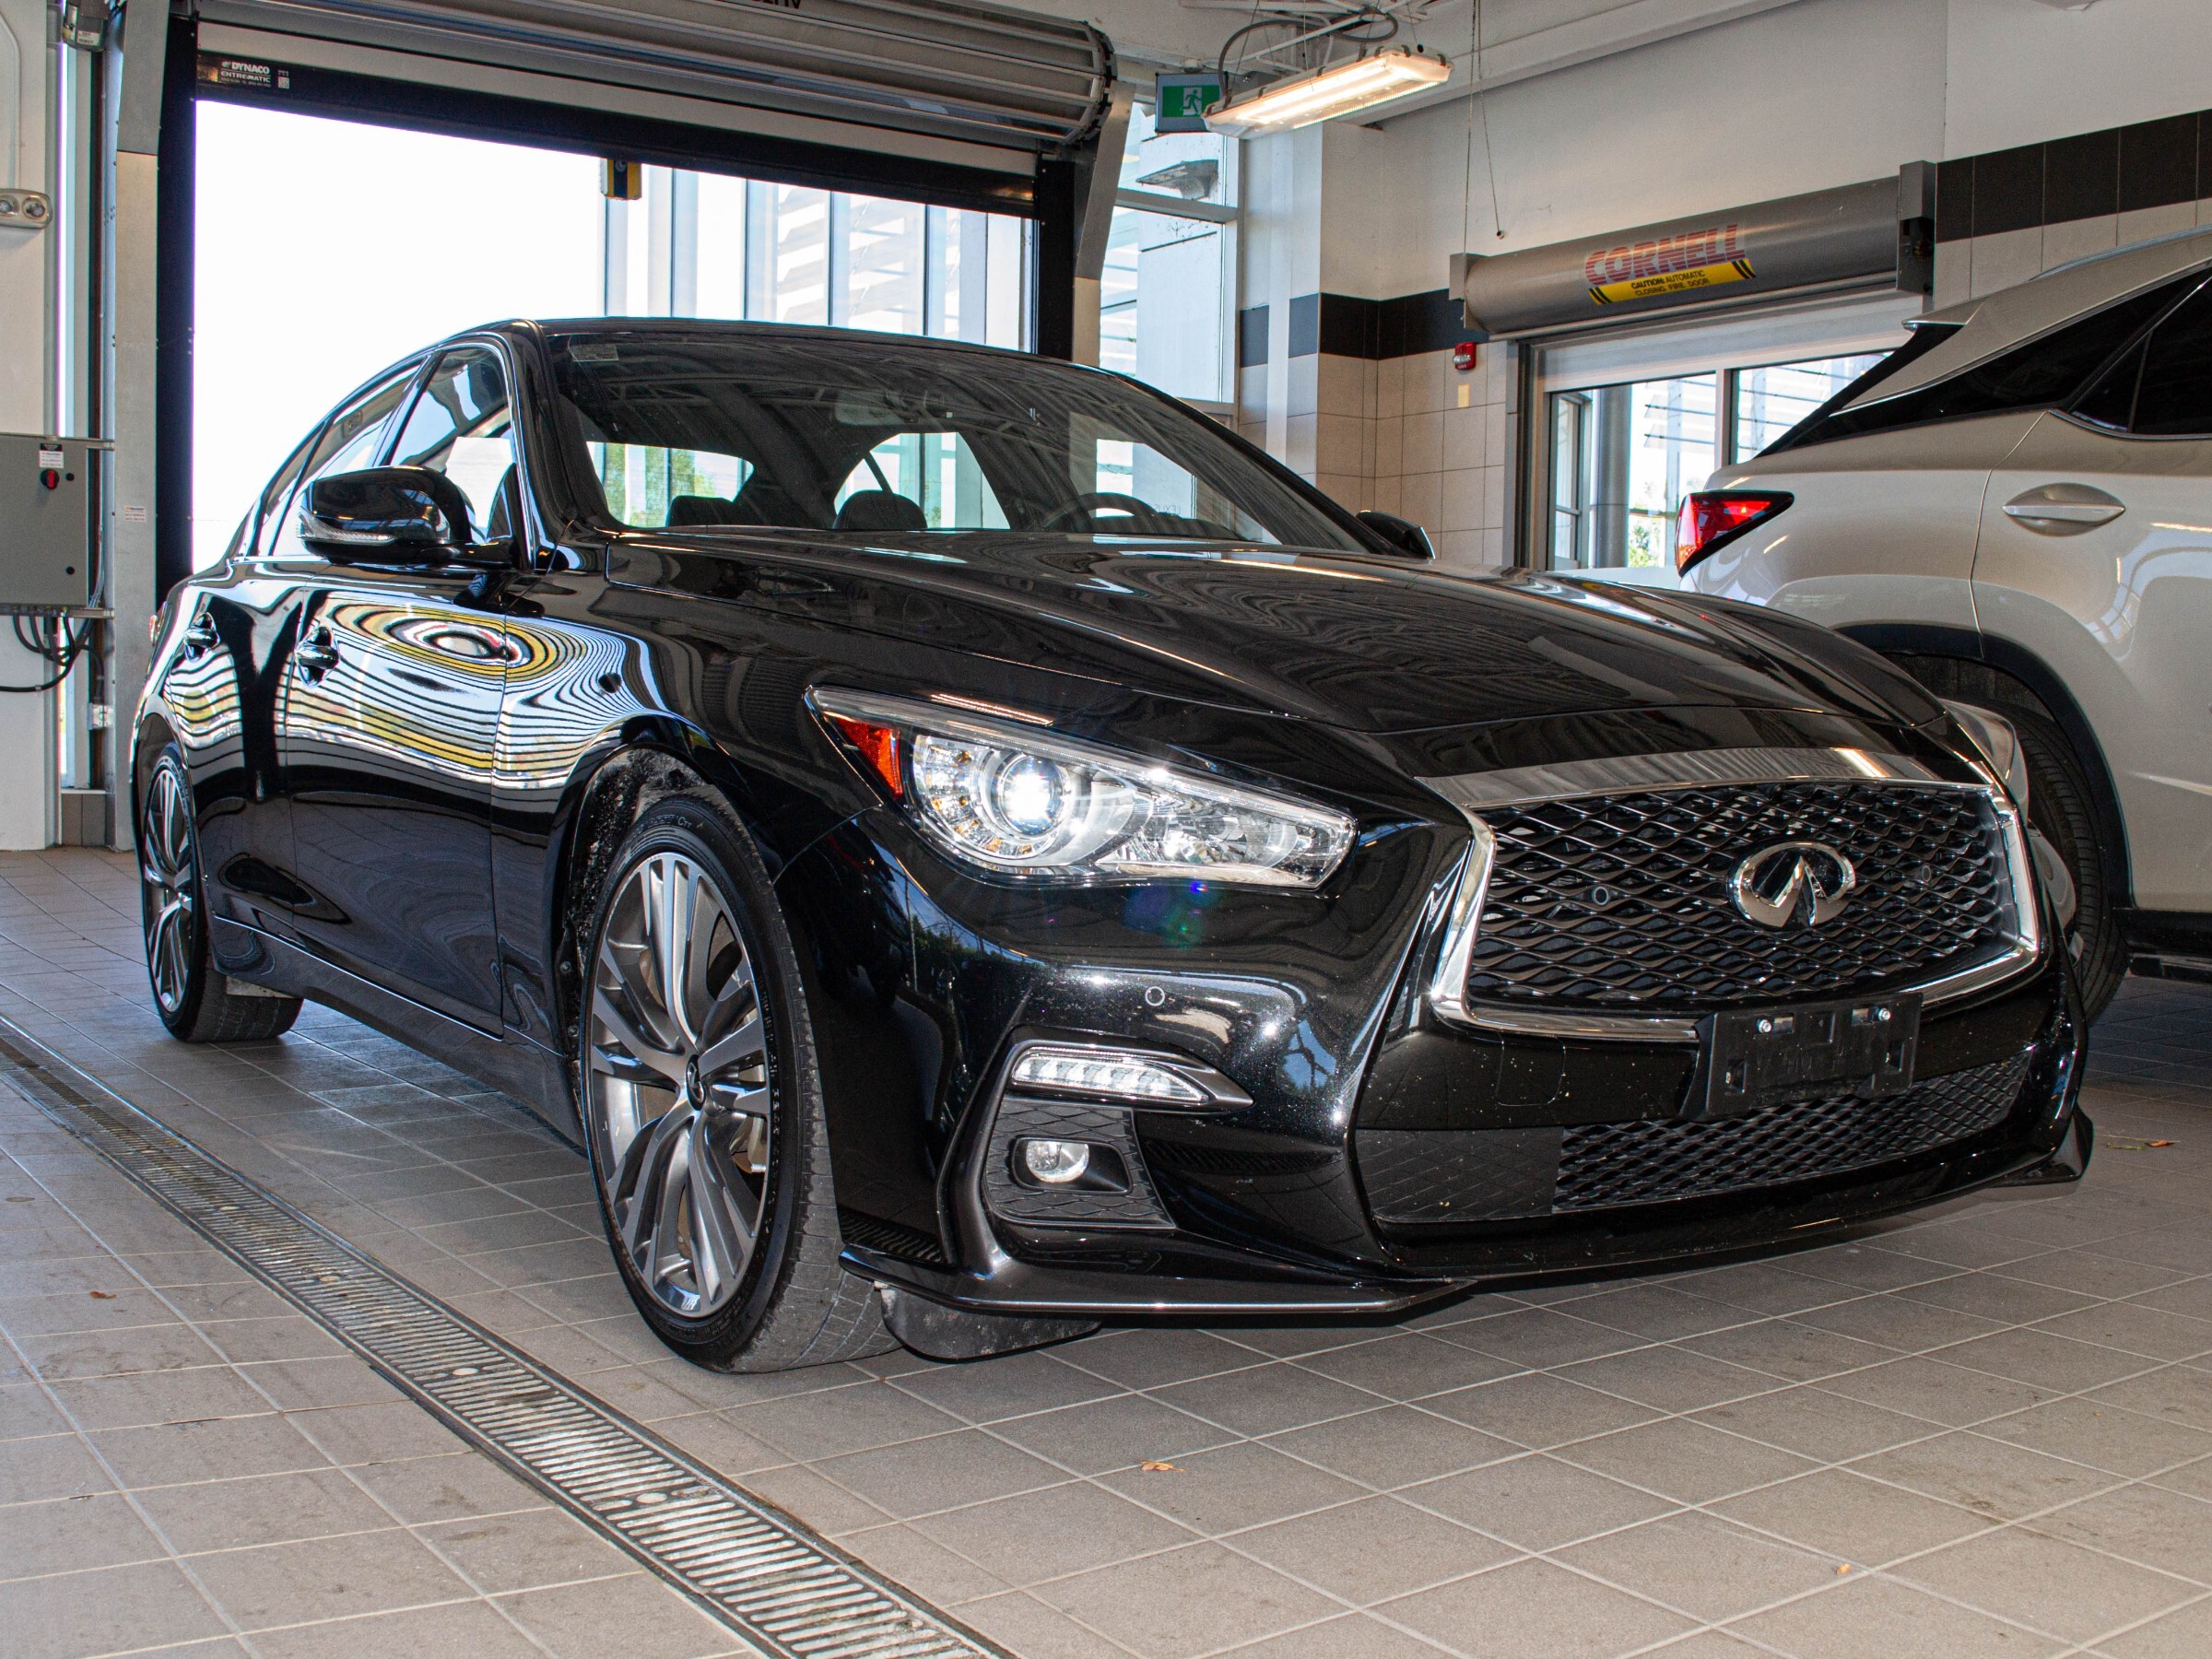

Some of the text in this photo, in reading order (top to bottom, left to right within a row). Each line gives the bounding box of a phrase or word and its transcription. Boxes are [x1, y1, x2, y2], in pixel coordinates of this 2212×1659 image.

[221, 71, 271, 83] ENTREMATIC
[231, 61, 270, 75] DYNACO
[1585, 224, 1746, 286] CORNELL
[1630, 269, 1705, 289] CAUTION: AUTOMATIC
[1635, 277, 1711, 297] CLOSING FIRE DOOR
